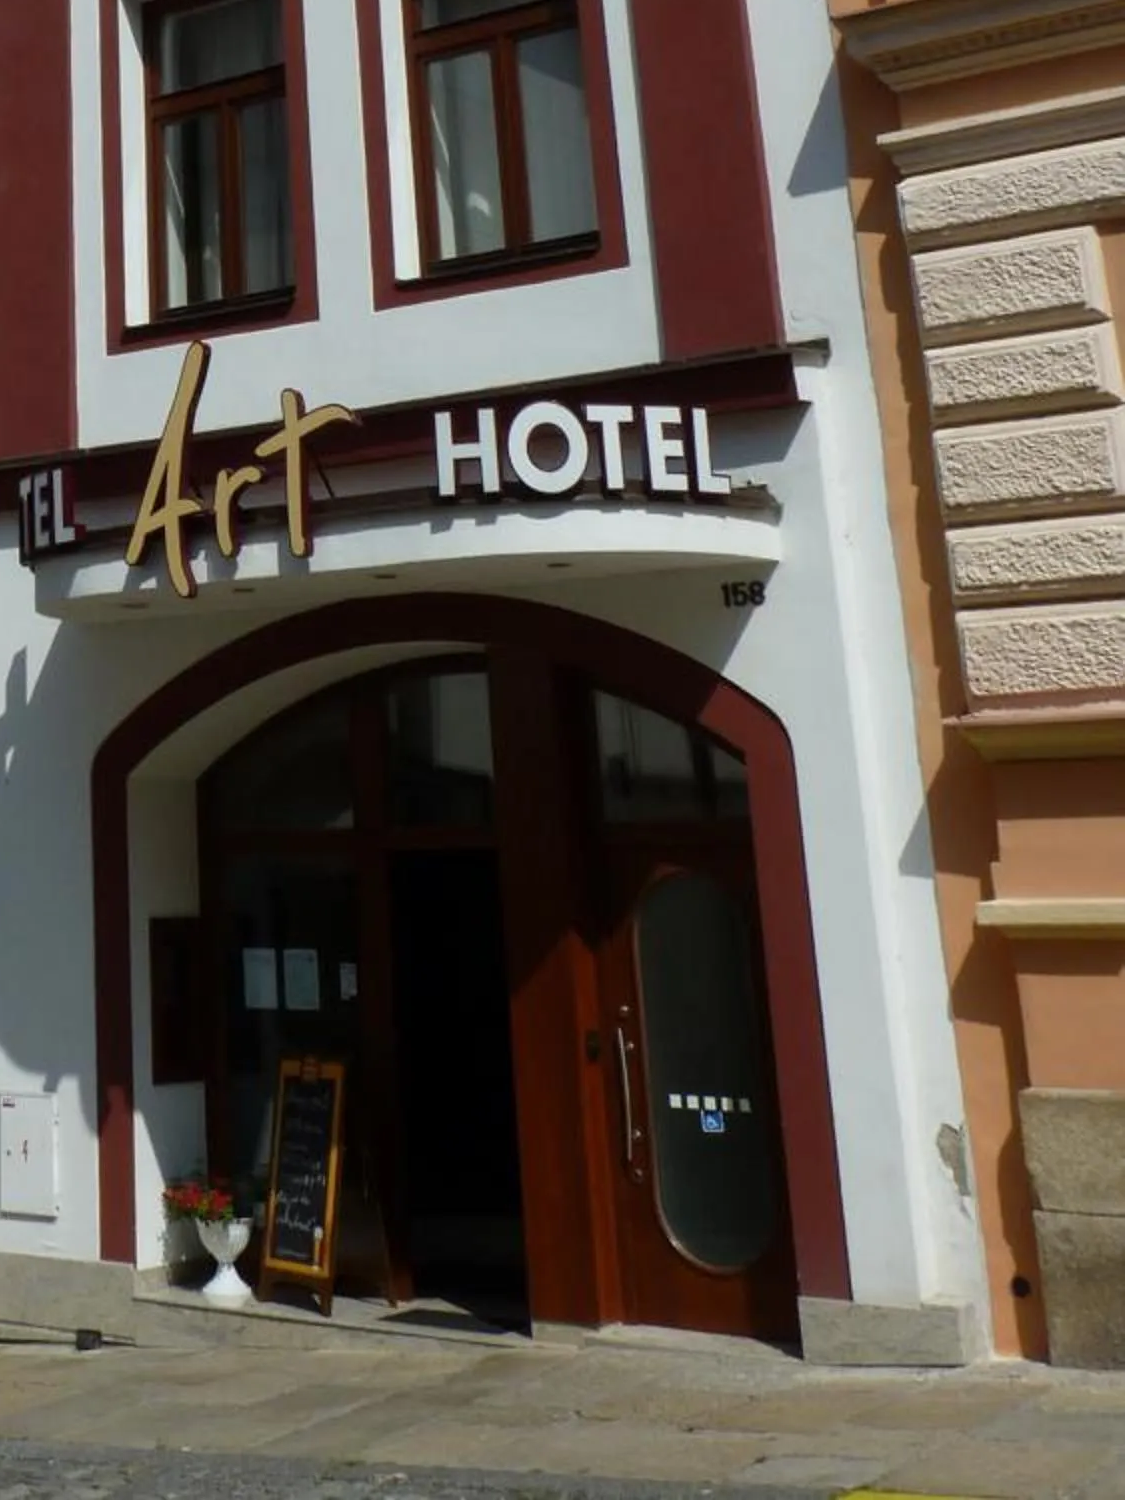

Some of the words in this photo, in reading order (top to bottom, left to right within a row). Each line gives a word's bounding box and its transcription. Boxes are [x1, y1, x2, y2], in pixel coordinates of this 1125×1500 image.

[126, 340, 359, 598] Art
[434, 401, 732, 498] HOTEL
[720, 581, 766, 608] 158
